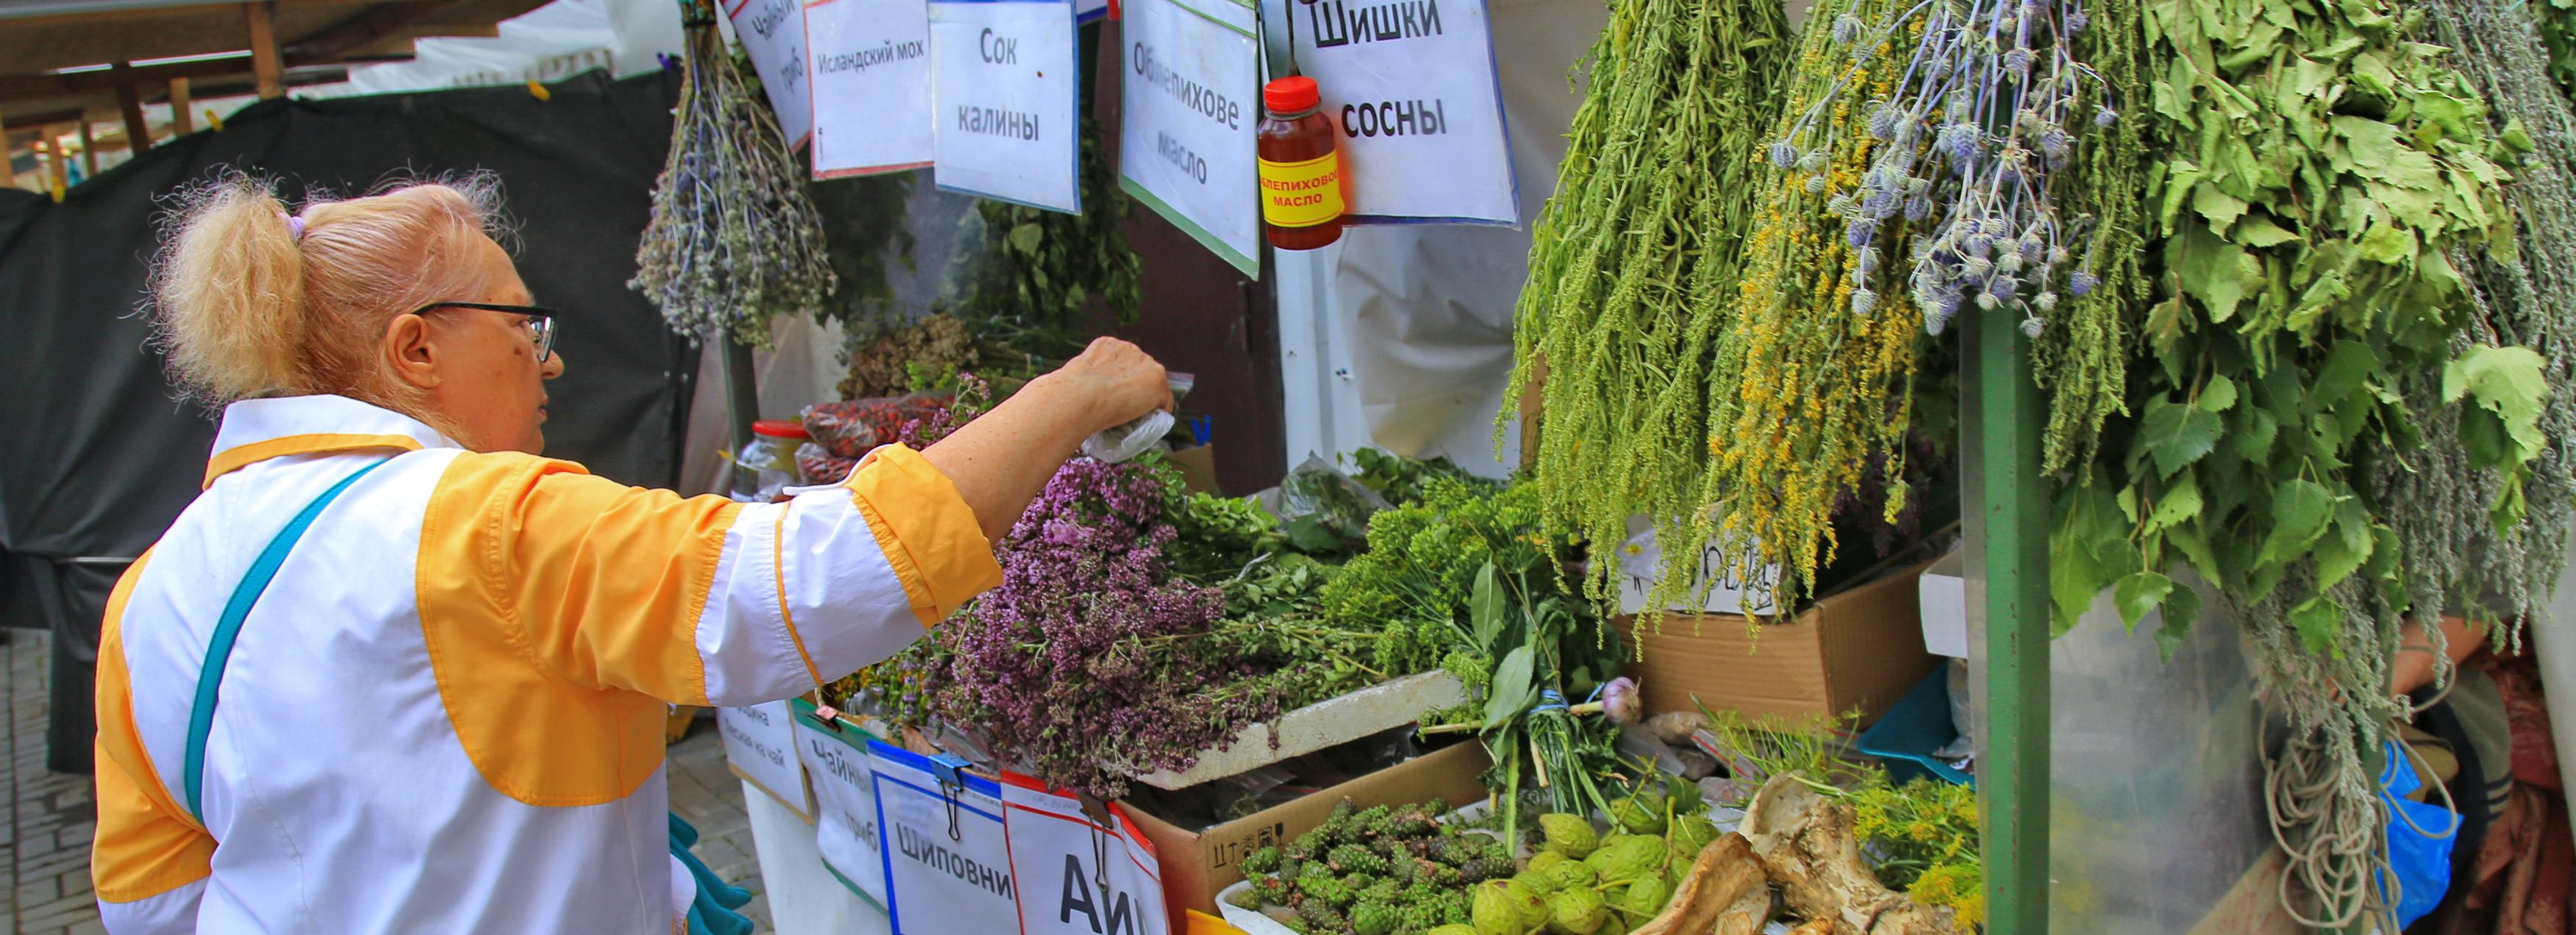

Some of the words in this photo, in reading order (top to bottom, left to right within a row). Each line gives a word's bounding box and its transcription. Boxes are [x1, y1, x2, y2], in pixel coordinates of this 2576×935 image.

[1310, 0, 1442, 48] Шишки
[817, 40, 894, 74] Исландский
[897, 40, 924, 62] мох
[980, 27, 1017, 65] Сок
[1134, 41, 1239, 130] Облепихове
[958, 105, 1039, 141] калины
[1341, 99, 1446, 138] сосны
[1158, 130, 1207, 185] масло
[1273, 193, 1322, 207] МАСЛО
[844, 810, 877, 852] гриб
[1060, 854, 1144, 935] Аи
